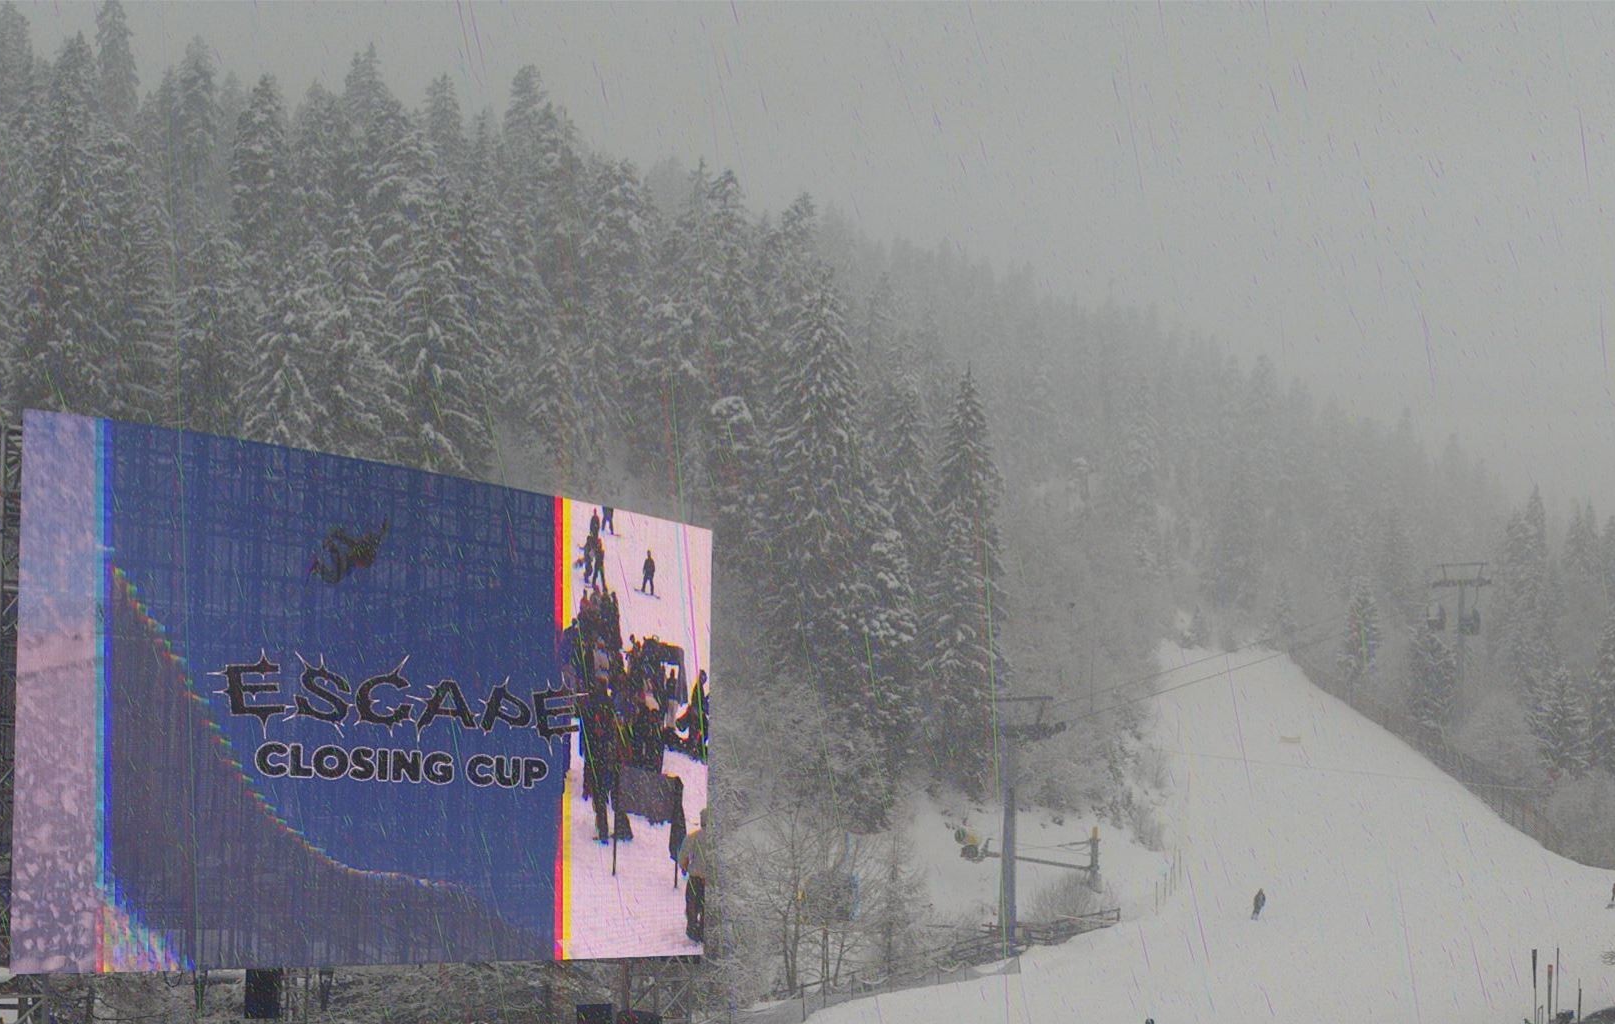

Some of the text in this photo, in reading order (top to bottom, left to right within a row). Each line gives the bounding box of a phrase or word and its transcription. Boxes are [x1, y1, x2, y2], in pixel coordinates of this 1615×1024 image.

[210, 651, 586, 751] ESCAPE
[254, 741, 549, 788] CLOSING CUP
